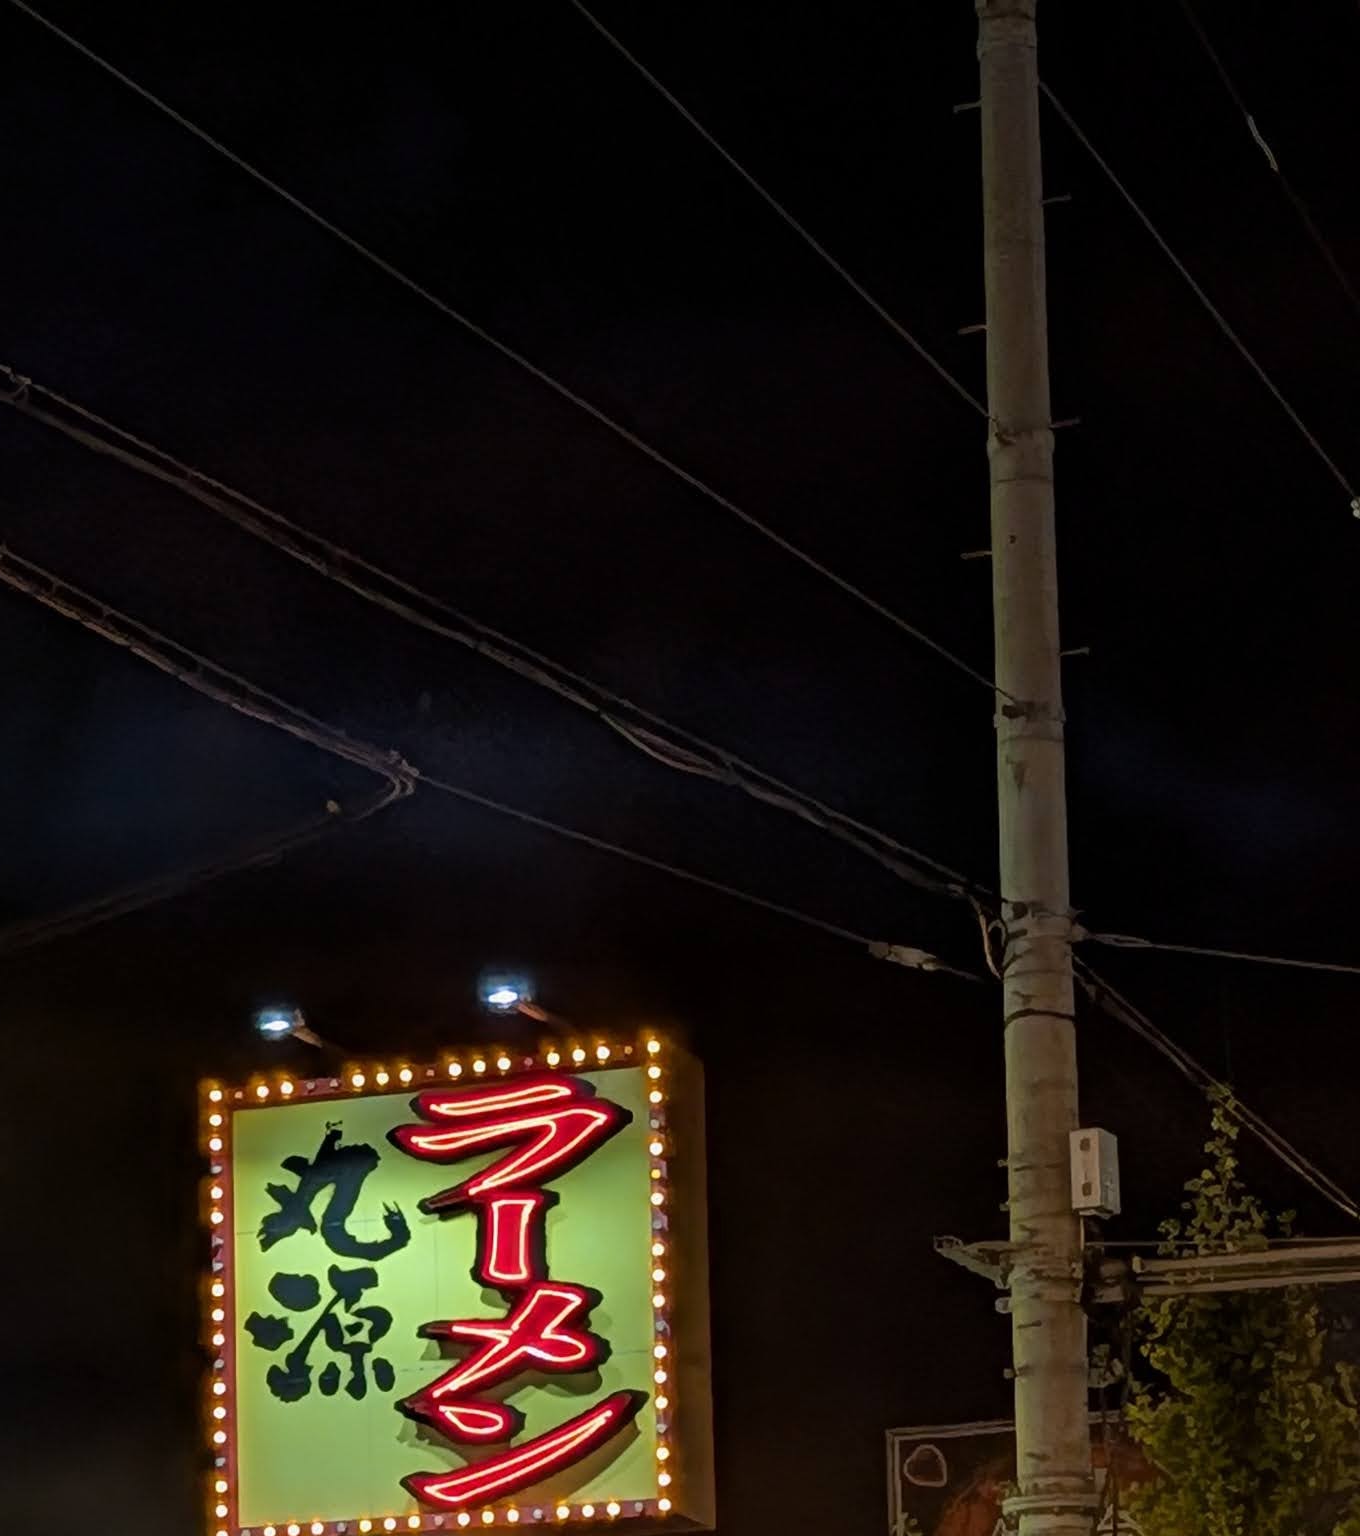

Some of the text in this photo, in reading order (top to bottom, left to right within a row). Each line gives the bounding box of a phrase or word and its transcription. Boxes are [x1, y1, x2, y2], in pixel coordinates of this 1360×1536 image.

[245, 1120, 411, 1402] 丸源
[387, 1076, 649, 1507] ラーメン
